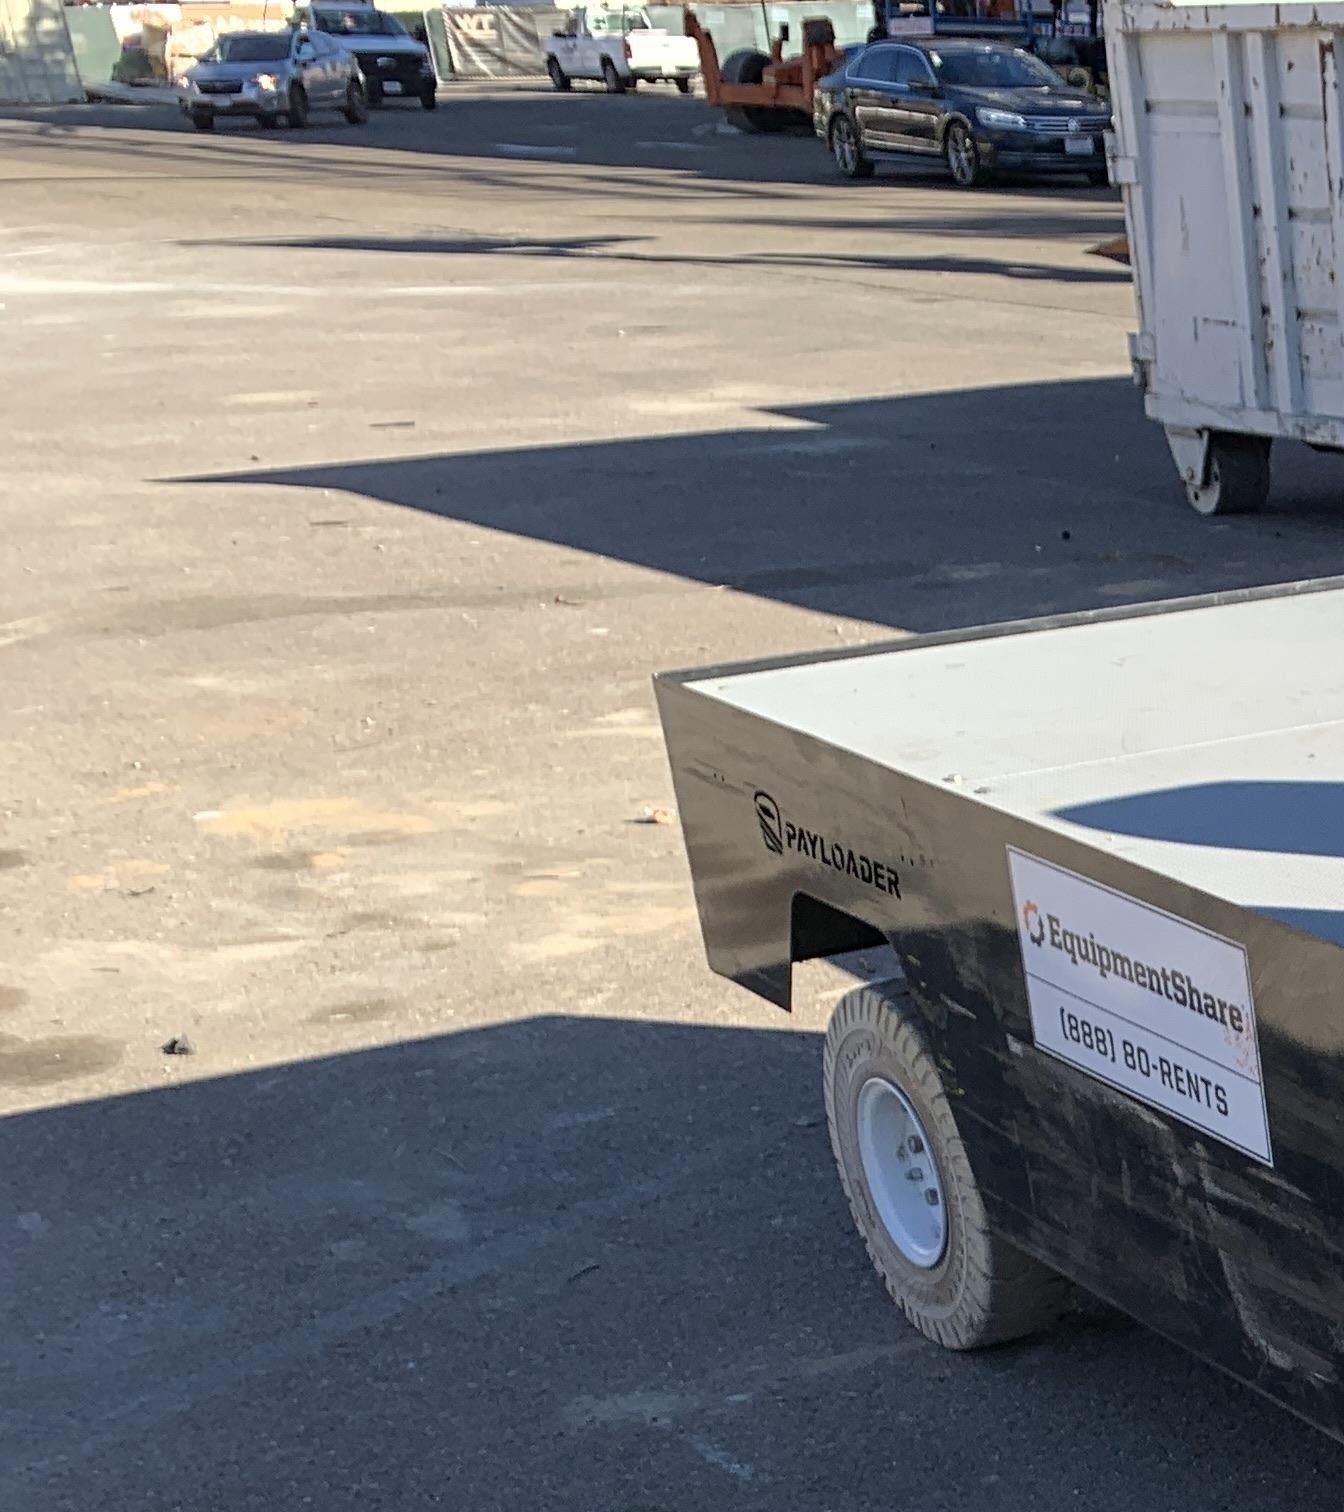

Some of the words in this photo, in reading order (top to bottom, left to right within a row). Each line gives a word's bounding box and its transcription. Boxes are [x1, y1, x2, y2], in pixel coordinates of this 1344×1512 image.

[785, 822, 901, 899] PAYLOADER
[1046, 913, 1244, 1033] EquipmentShare
[1060, 1005, 1117, 1064] (888)
[1123, 1037, 1230, 1117] 80-RENTS
